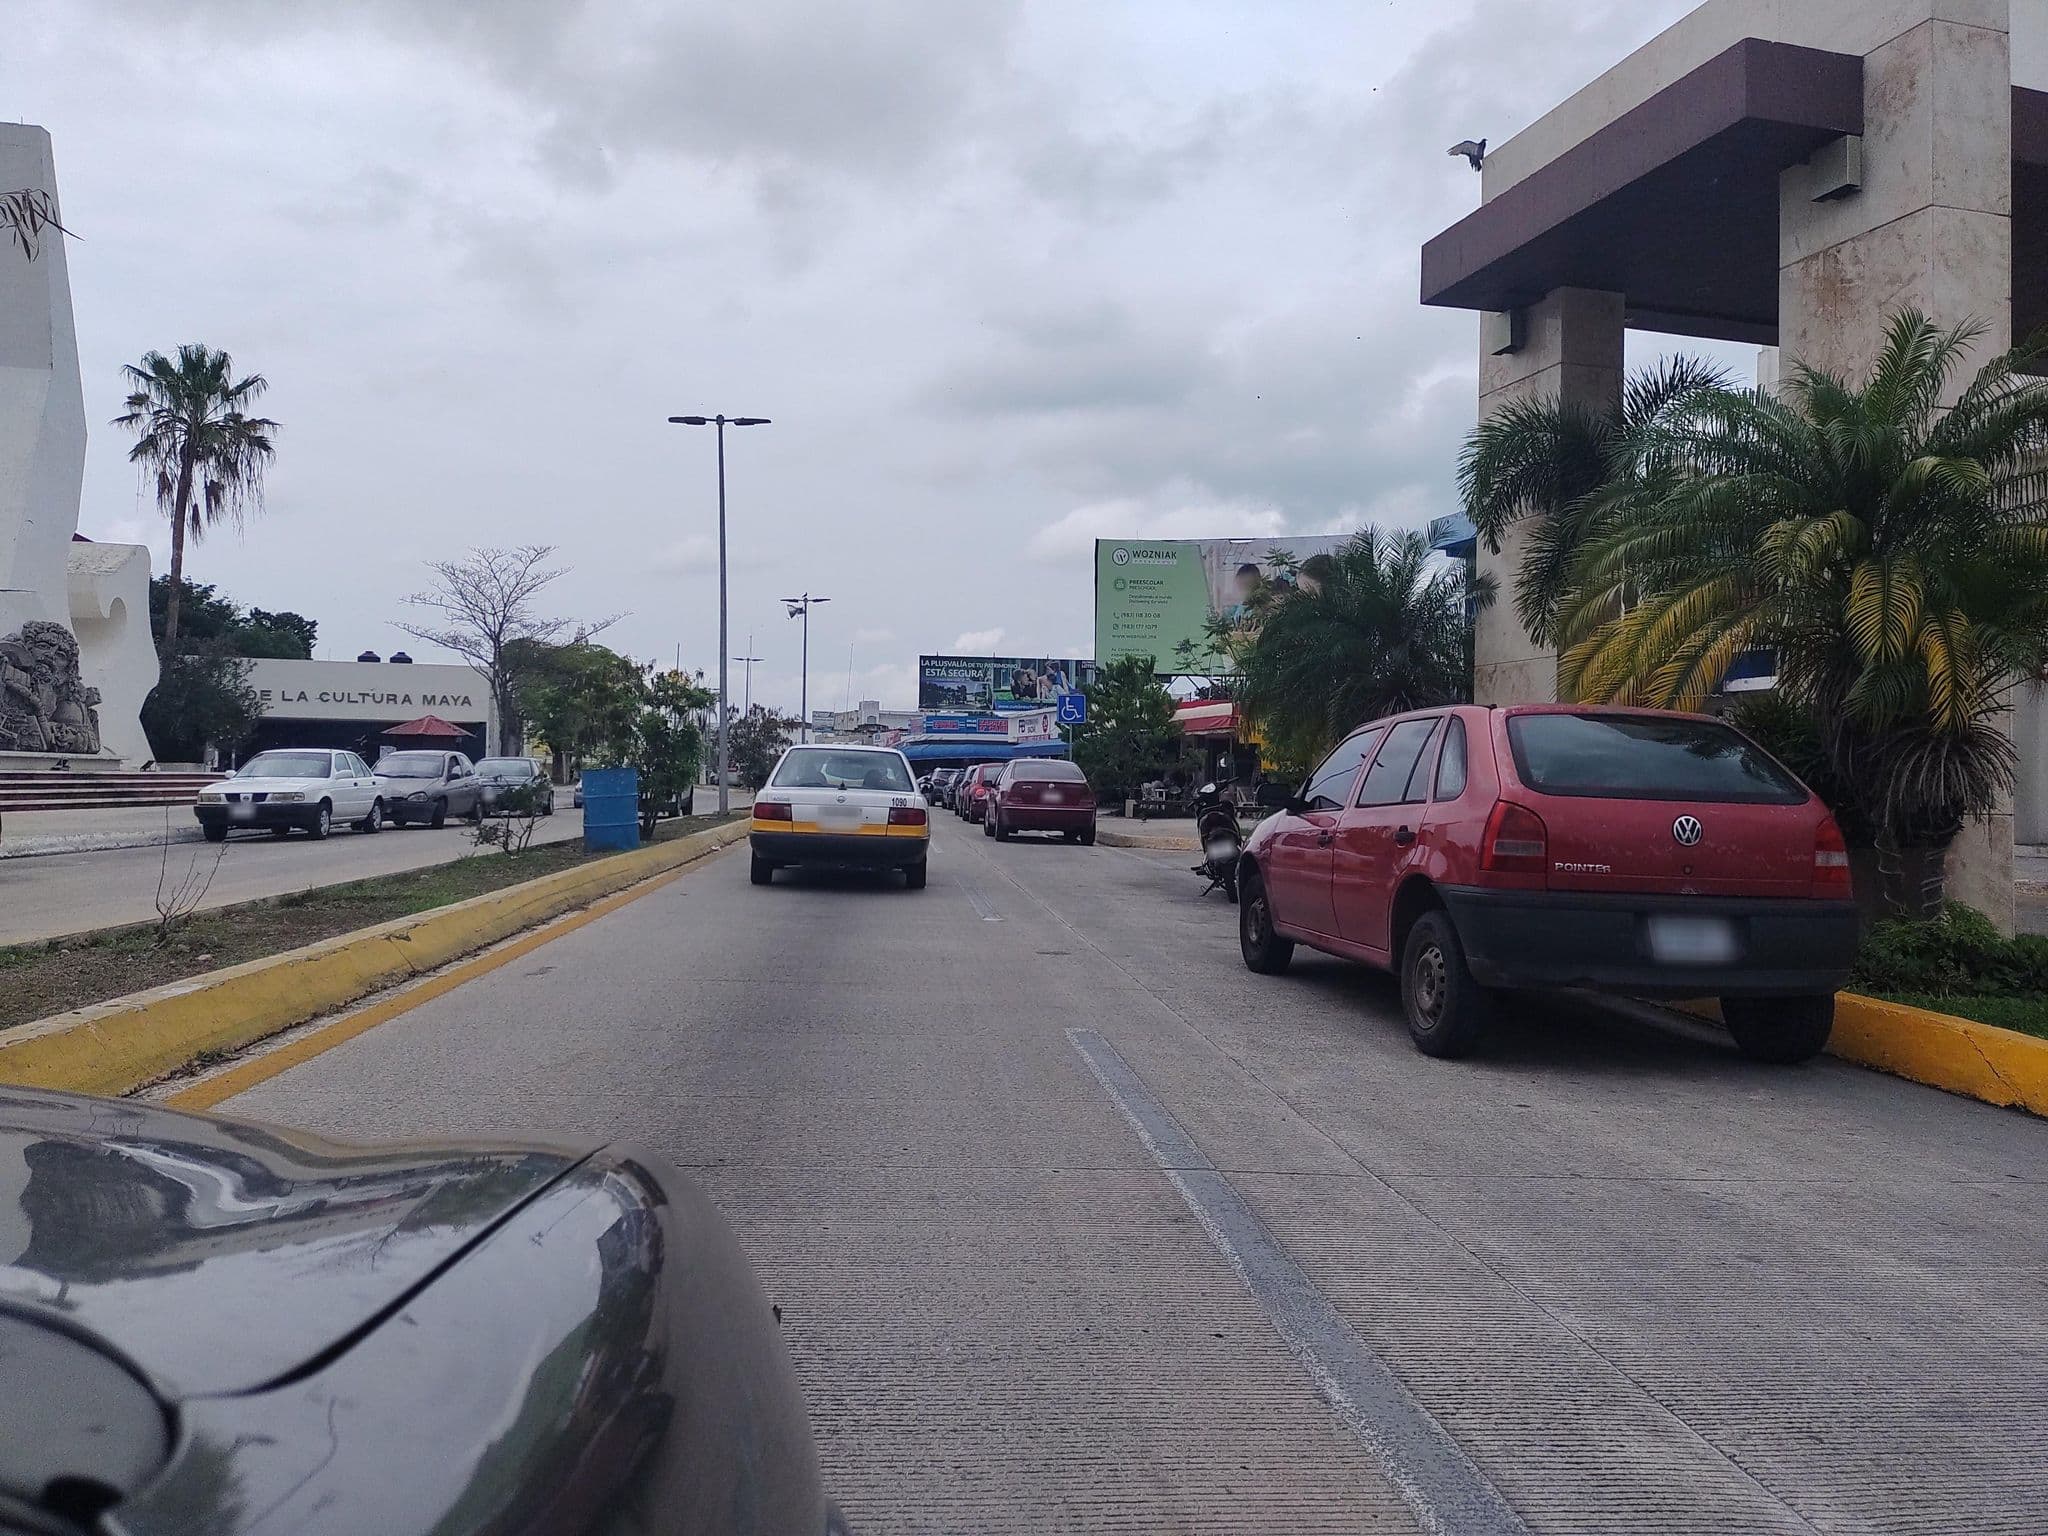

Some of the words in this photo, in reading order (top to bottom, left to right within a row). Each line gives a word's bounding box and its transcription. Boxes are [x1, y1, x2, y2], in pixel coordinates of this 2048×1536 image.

[1132, 550, 1177, 560] WOZNIAK
[921, 659, 930, 667] LA
[931, 659, 968, 668] PLUSVALÍA
[926, 666, 947, 677] ESTÁ
[948, 669, 984, 678] SEGURA
[281, 690, 309, 702] LA
[318, 690, 413, 706] CULTURA
[422, 694, 473, 707] MAYA
[891, 797, 908, 807] 1090
[1554, 861, 1611, 875] POINTER
